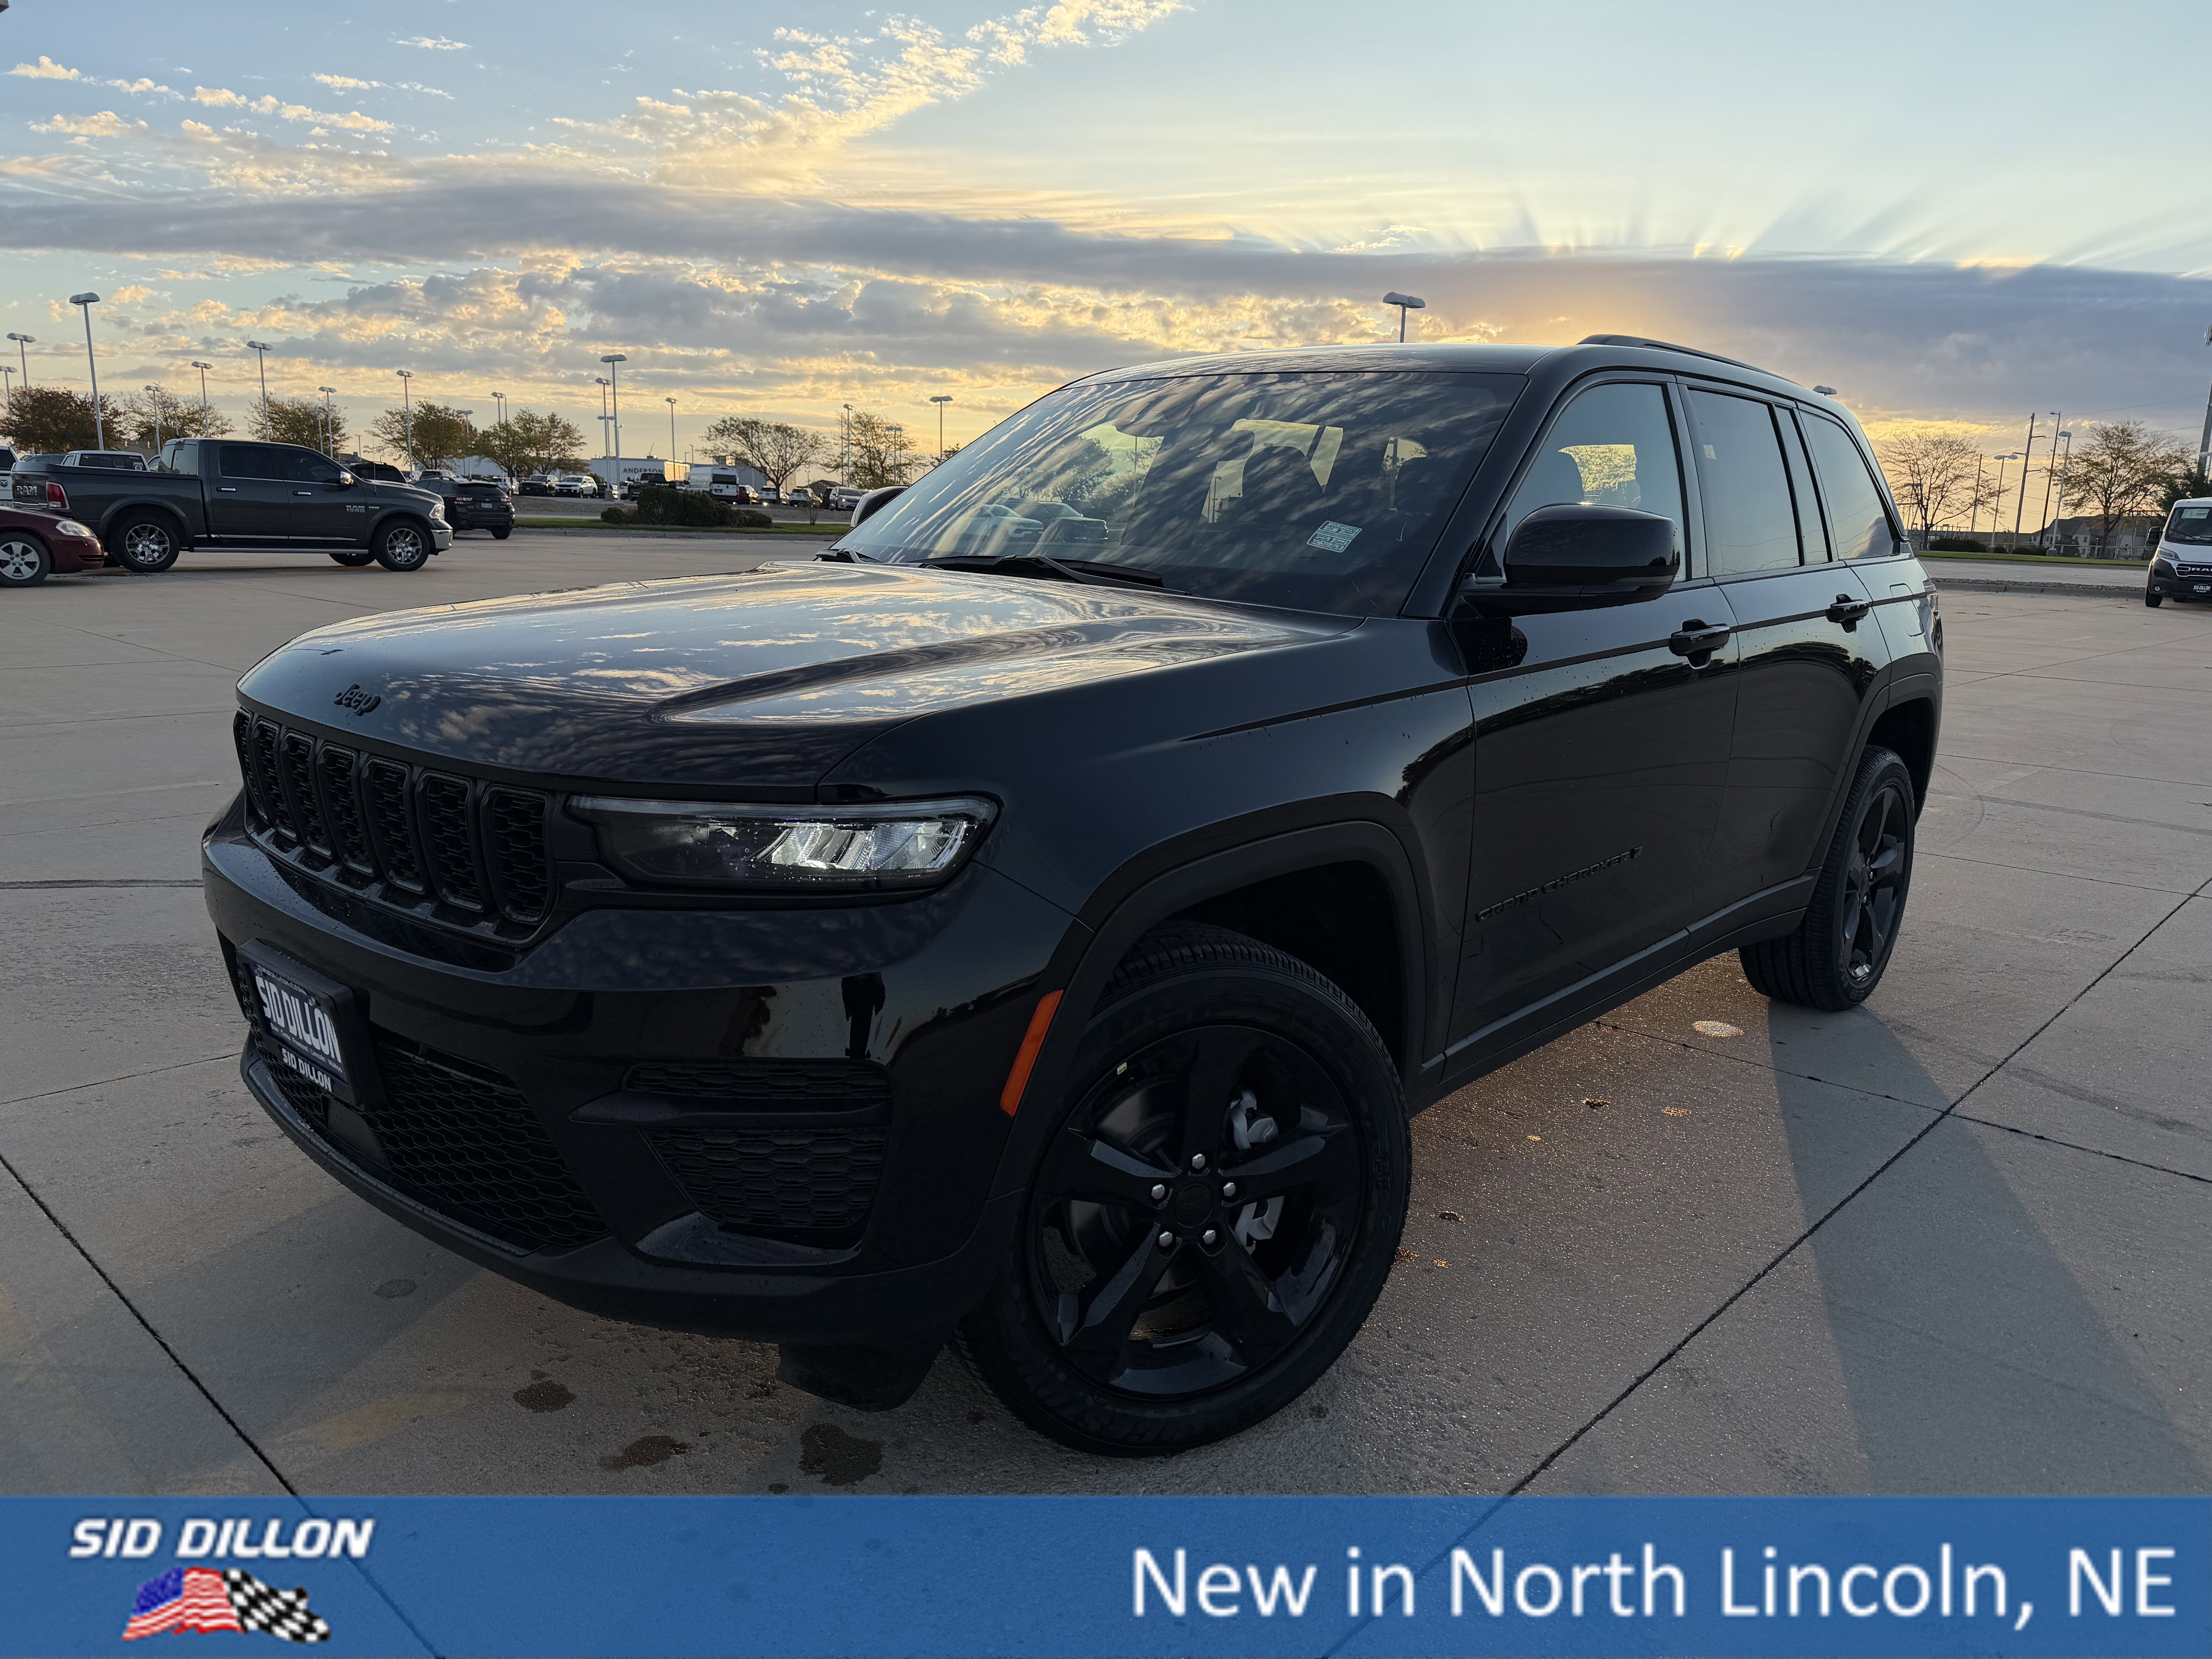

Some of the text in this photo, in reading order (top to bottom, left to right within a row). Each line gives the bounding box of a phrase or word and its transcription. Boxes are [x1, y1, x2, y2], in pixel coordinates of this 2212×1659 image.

[17, 486, 37, 496] RAM
[333, 684, 381, 716] Jeep
[255, 975, 285, 1029] SID
[281, 989, 342, 1064] DILLON
[282, 1048, 332, 1092] SID DILLON
